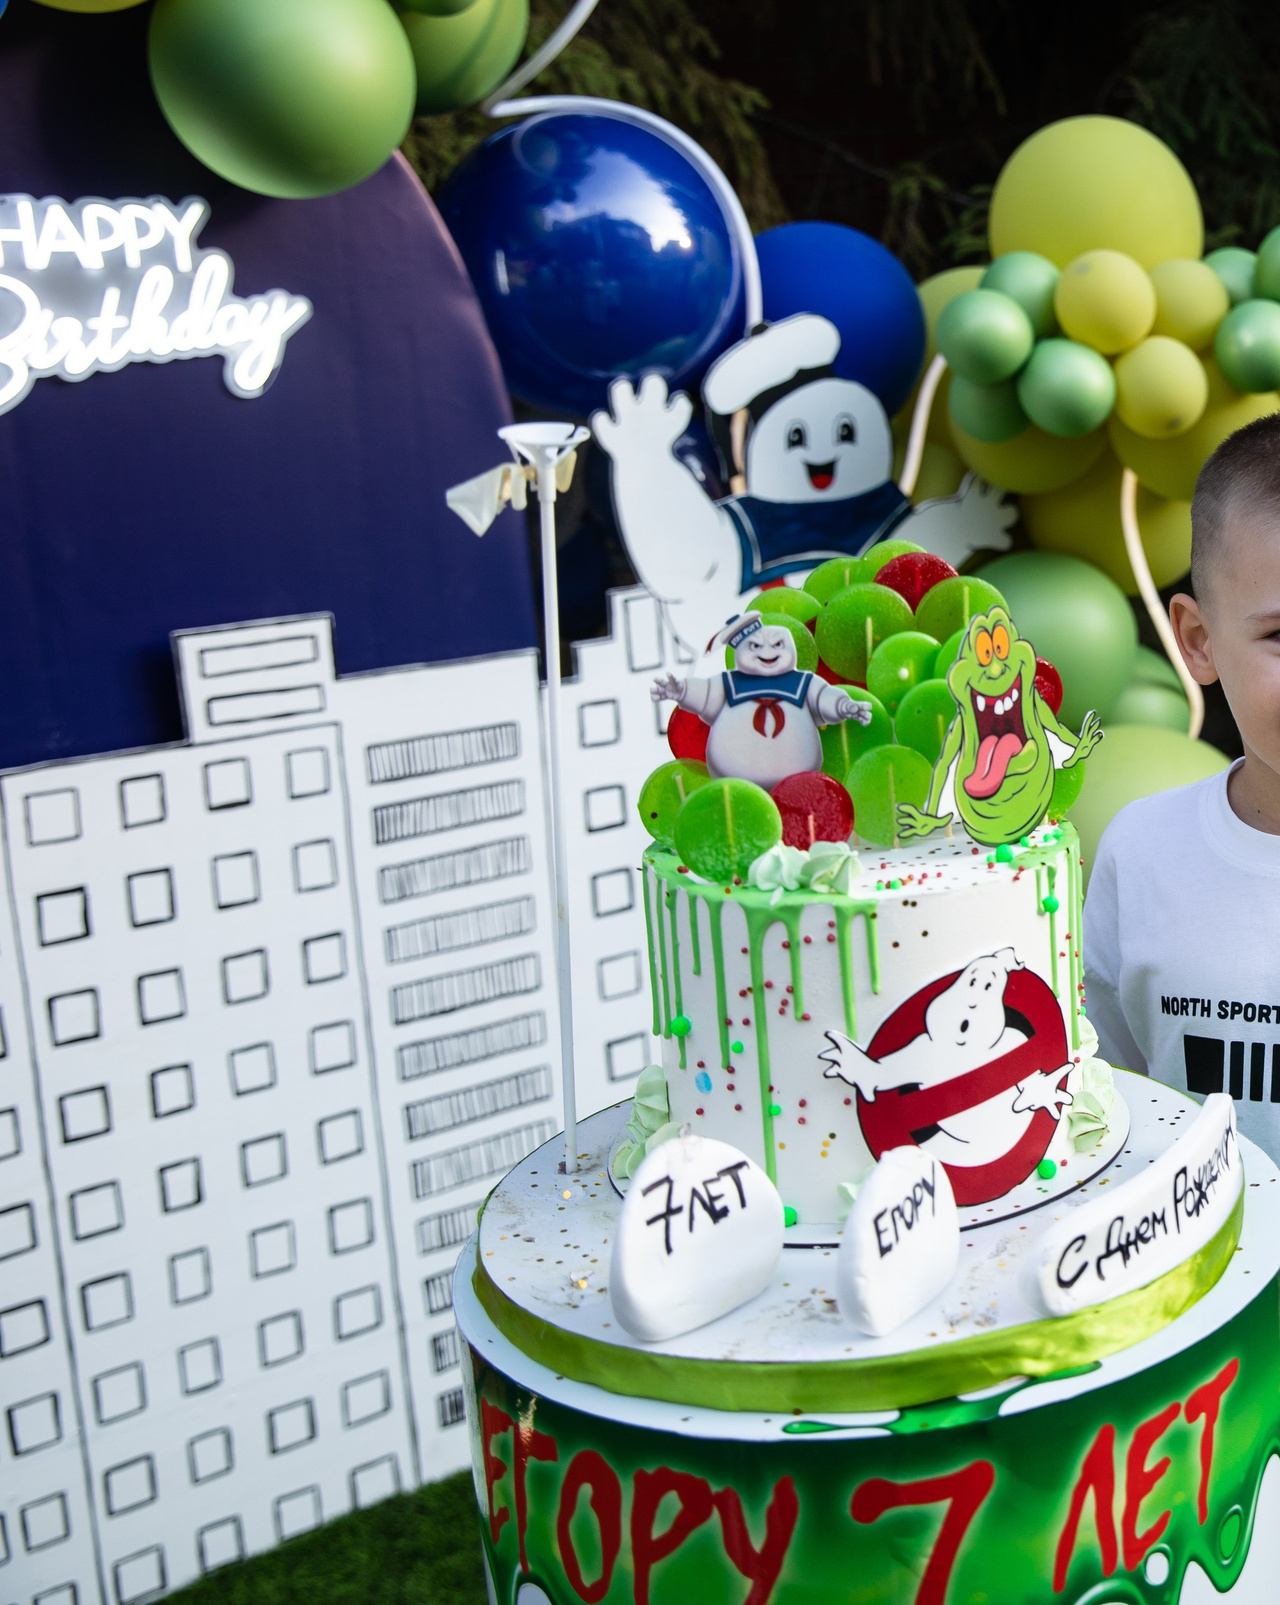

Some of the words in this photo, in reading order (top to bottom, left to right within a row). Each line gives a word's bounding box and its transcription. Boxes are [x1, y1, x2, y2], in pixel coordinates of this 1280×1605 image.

[0, 199, 206, 272] HAPPY
[1160, 996, 1211, 1018] NORTH
[641, 1173, 684, 1256] 7
[1056, 1233, 1089, 1289] С
[481, 1397, 799, 1605] ЕГОРУ
[850, 1459, 996, 1605] 7
[1051, 1357, 1241, 1594] ЛЕТ
